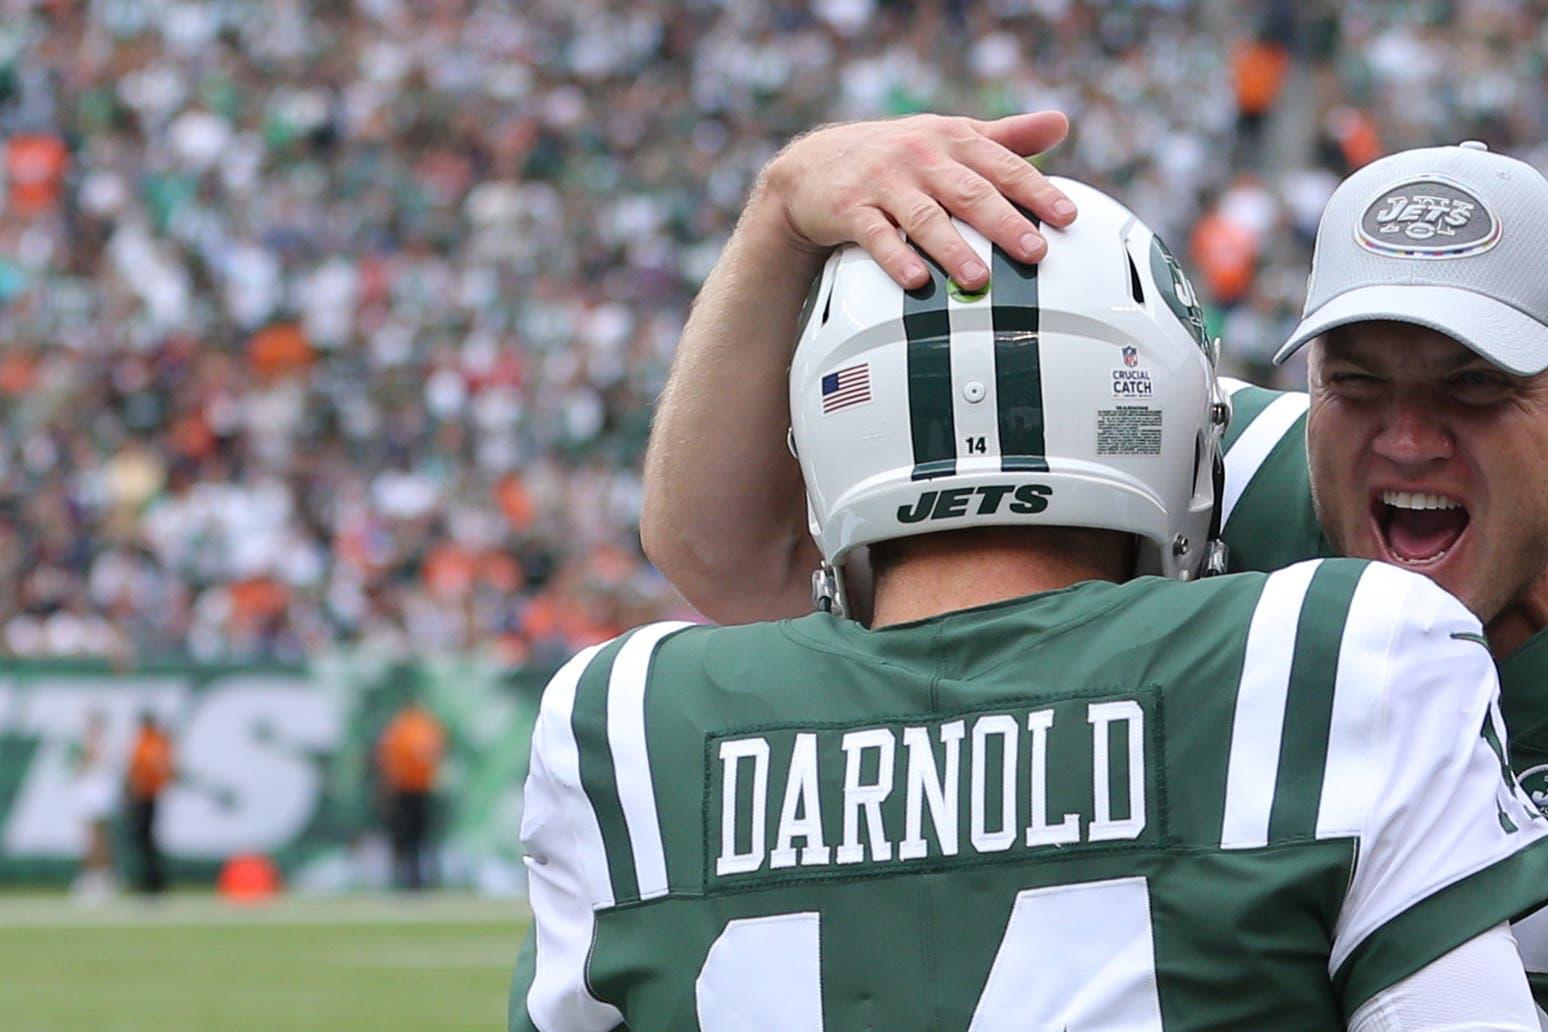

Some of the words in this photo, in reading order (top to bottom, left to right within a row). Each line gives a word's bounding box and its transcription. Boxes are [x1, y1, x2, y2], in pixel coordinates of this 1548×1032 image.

[1376, 197, 1473, 228] JETS
[1112, 370, 1151, 380] CRUCIAL
[1113, 381, 1152, 393] CATCH
[965, 436, 987, 454] 14
[897, 484, 1053, 523] JETS
[716, 699, 1147, 877] DARNOLD
